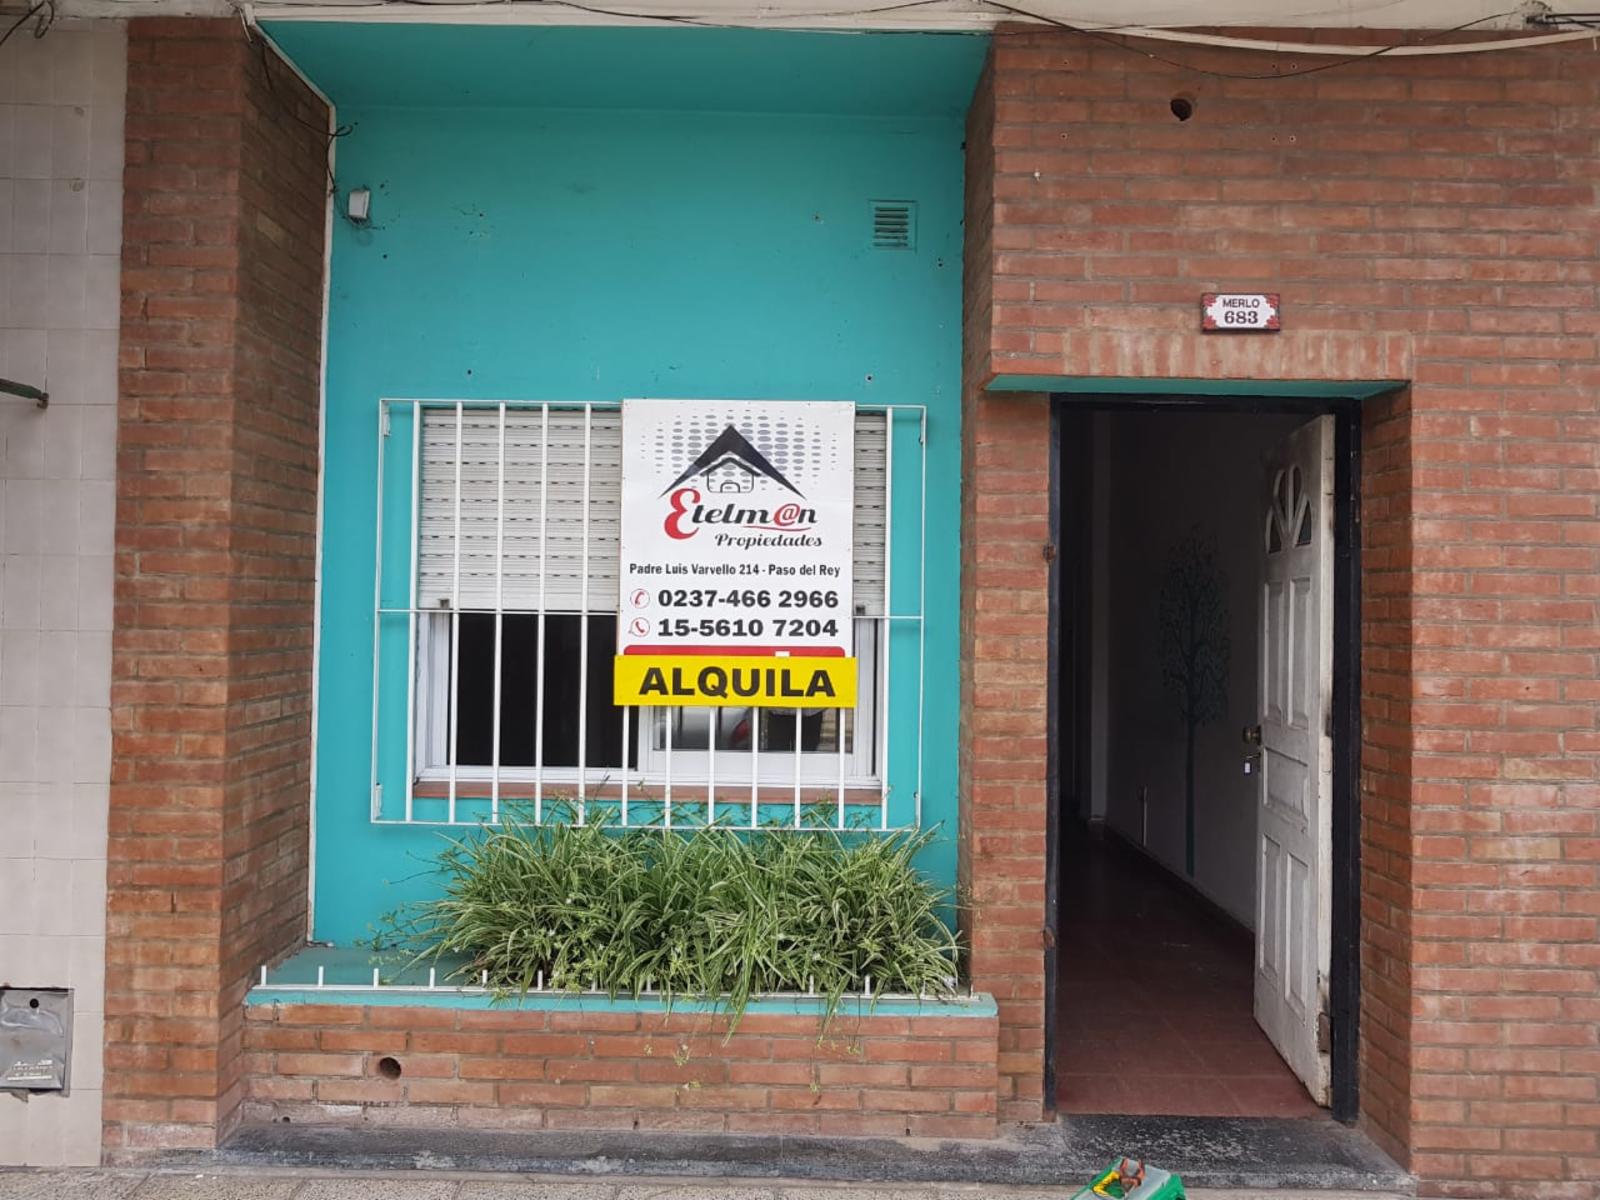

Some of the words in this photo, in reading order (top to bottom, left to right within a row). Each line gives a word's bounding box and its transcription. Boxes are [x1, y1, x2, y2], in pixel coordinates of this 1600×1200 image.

[1223, 298, 1260, 308] MERLO
[1224, 311, 1258, 324] 683
[664, 488, 818, 540] Etelm@n
[715, 533, 822, 550] Propiedades
[629, 563, 662, 575] Padre
[665, 563, 688, 575] Luis
[692, 563, 735, 575] Varvello
[739, 564, 759, 575] 214
[768, 564, 795, 576] Paso
[800, 564, 816, 576] del
[820, 564, 840, 578] Rey
[658, 589, 771, 607] 0237-466
[778, 590, 838, 608] 2966
[658, 619, 763, 637] 15-5610
[772, 619, 838, 637] 7204
[638, 666, 836, 699] ALQUILA
